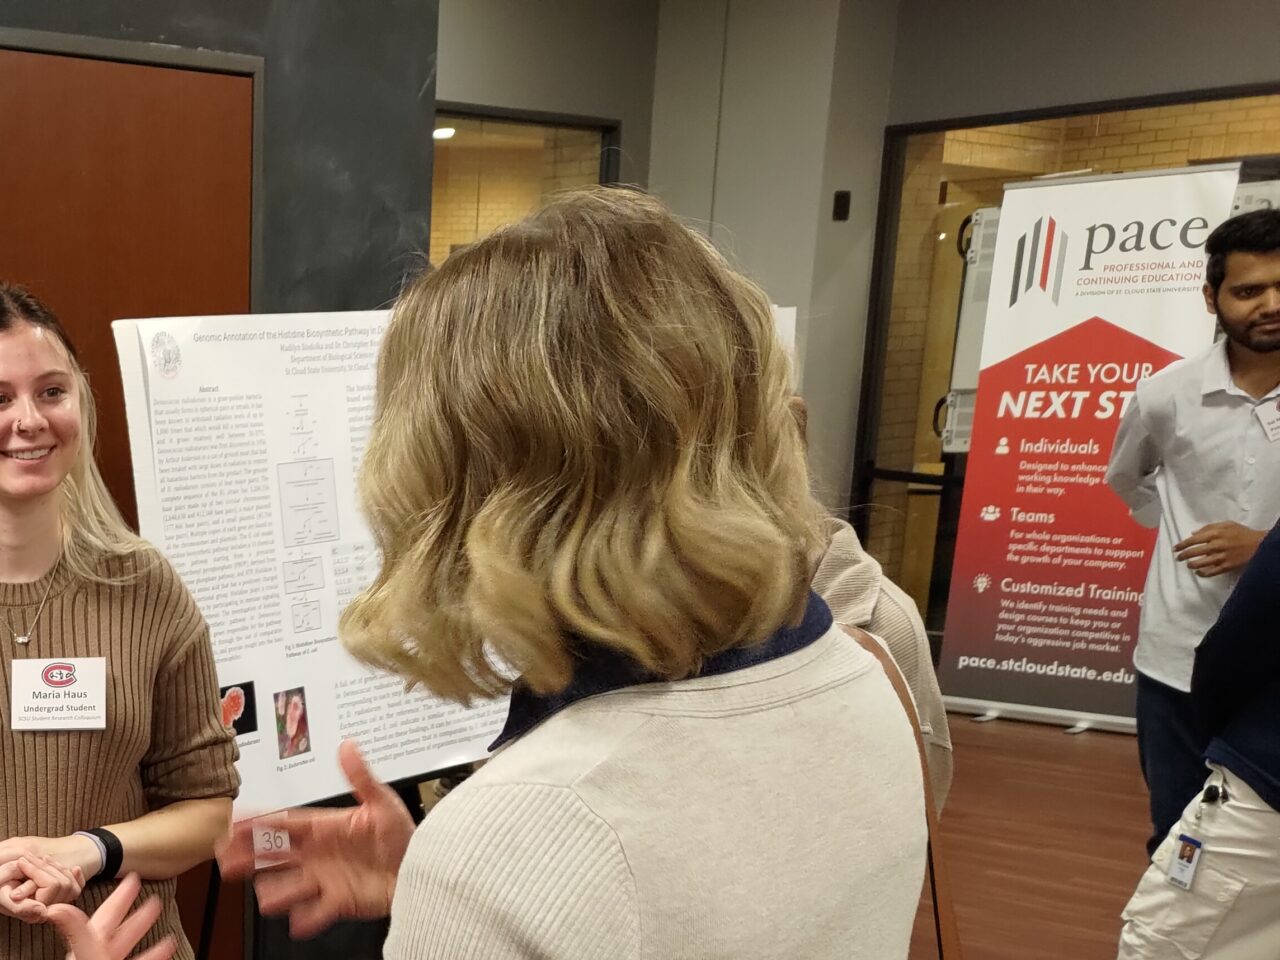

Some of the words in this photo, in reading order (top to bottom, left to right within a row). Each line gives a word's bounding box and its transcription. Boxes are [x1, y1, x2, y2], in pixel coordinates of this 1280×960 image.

[1079, 217, 1208, 271] pace
[1103, 262, 1176, 272] PROFESSIONAL
[1179, 260, 1203, 268] AND
[1077, 275, 1139, 286] CONTINUING
[1142, 273, 1201, 283] EDUCATION
[223, 332, 258, 341] Annotation
[266, 331, 276, 339] the
[1025, 364, 1080, 384] TAKE
[1087, 363, 1153, 384] YOUR
[996, 391, 1090, 419] NEXT
[1020, 439, 1100, 454] Individuals
[1019, 461, 1059, 471] Designed
[1060, 462, 1069, 471] to
[1071, 463, 1107, 472] enhance
[1018, 474, 1051, 484] working
[1053, 473, 1100, 486] knowledge
[1026, 485, 1044, 493] their
[1047, 487, 1065, 496] way.
[1010, 508, 1055, 523] Teams
[1010, 529, 1023, 539] For
[1025, 531, 1050, 541] whole
[1052, 533, 1111, 544] organizations
[1008, 542, 1038, 552] specific
[1040, 544, 1092, 555] departments
[1094, 547, 1103, 555] to
[1007, 554, 1020, 562] the
[1021, 554, 1050, 564] growth
[1053, 555, 1061, 564] of
[1063, 558, 1082, 567] your
[1084, 559, 1126, 570] company.
[1000, 578, 1084, 597] Customized
[1089, 584, 1145, 607] Training
[1001, 599, 1014, 608] We
[1016, 601, 1047, 612] identify
[1049, 603, 1080, 615] training
[1083, 607, 1108, 616] needs
[1110, 608, 1128, 618] and
[999, 611, 1025, 621] design
[1027, 614, 1057, 623] courses
[1060, 616, 1068, 624] to
[1070, 615, 1090, 628] keep
[1092, 620, 1109, 628] you
[997, 623, 1016, 632] your
[1017, 623, 1070, 636] organization
[1071, 628, 1120, 642] competitive
[1122, 632, 1130, 642] in
[995, 633, 1025, 643] today's
[1027, 637, 1071, 648] aggressive
[1072, 639, 1087, 650] job
[958, 655, 1135, 684] pace.stcloudstate.edu
[32, 691, 60, 699] Maria
[24, 705, 64, 713] Undergrad
[262, 829, 283, 851] 36
